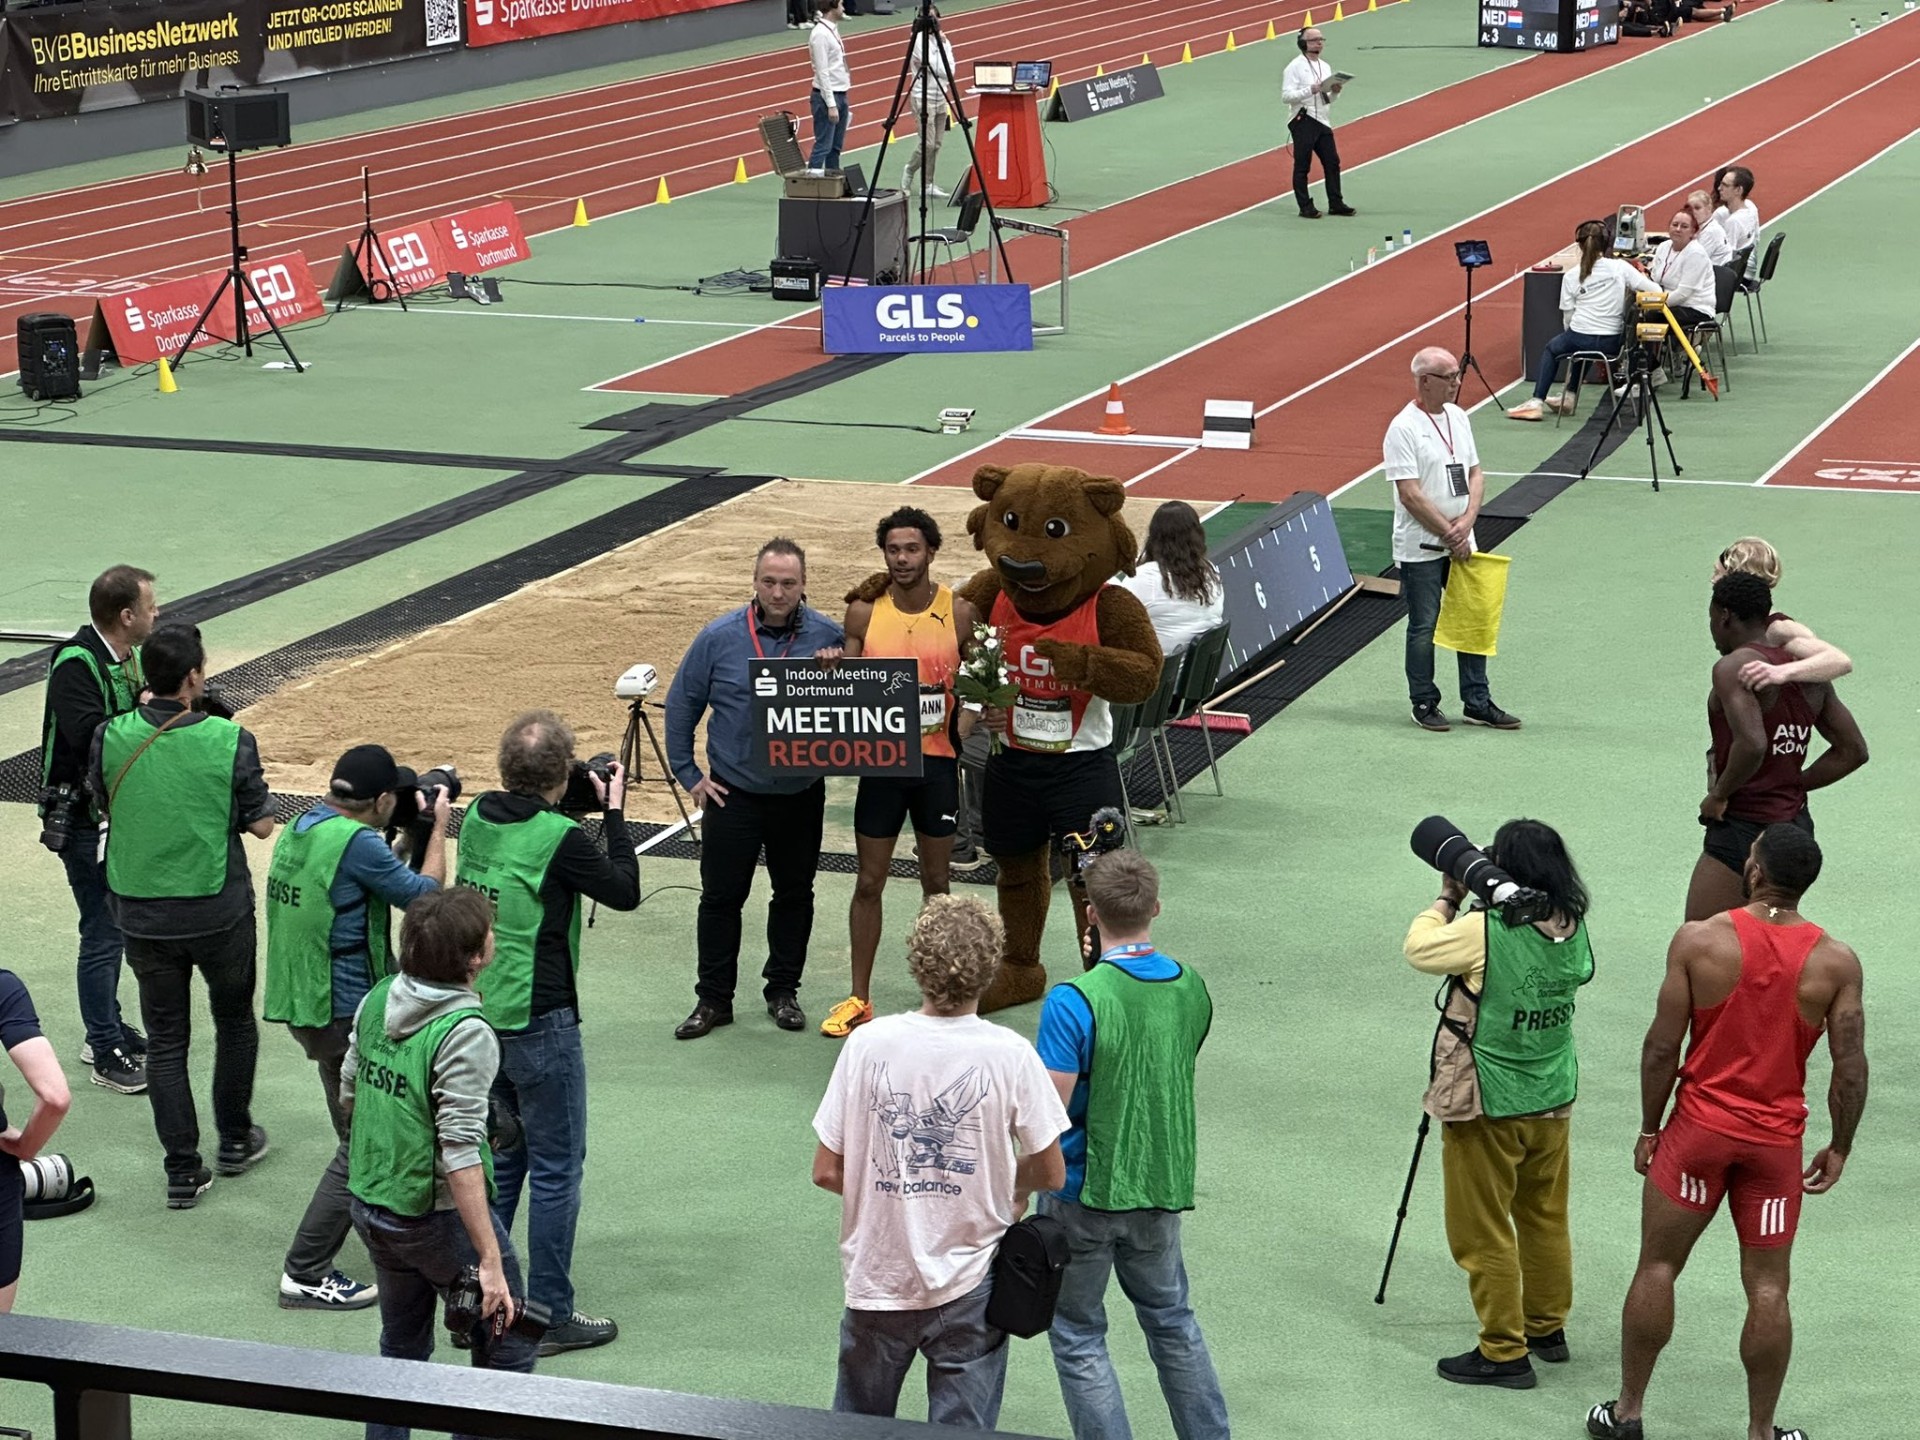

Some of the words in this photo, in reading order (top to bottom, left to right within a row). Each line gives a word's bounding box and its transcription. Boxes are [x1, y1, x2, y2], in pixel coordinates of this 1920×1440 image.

[267, 9, 301, 29] JETZT
[301, 2, 352, 24] QR-CODE
[353, 0, 403, 15] SCANNEN
[1482, 9, 1507, 26] NED
[1576, 12, 1589, 29] NED
[267, 33, 292, 51] UND
[293, 26, 343, 47] MITGLIED
[344, 18, 392, 39] WERDEN!
[1491, 28, 1499, 43] 3
[1534, 32, 1557, 48] 6.40
[1603, 24, 1617, 40] 6.40
[34, 73, 61, 93] Ihre
[60, 64, 137, 90] Eintrittskarte
[140, 58, 156, 78] für
[157, 54, 187, 75] mehr
[188, 49, 241, 71] Business.
[988, 122, 1008, 180] 1
[467, 225, 509, 248] Sparkasse
[476, 242, 517, 267] Dortmund
[147, 302, 200, 330] Sparkasse
[879, 333, 915, 342] Parcels
[918, 333, 928, 342] to
[931, 332, 965, 344] People
[1309, 545, 1321, 572] 5
[1255, 581, 1267, 609] 6
[785, 668, 827, 680] Indoor
[833, 667, 887, 683] Meeting
[786, 684, 854, 696] Dortmund
[767, 706, 906, 734] MEETING
[768, 740, 907, 767] RECORD!
[875, 1181, 900, 1194] new
[903, 1180, 962, 1195] balance
